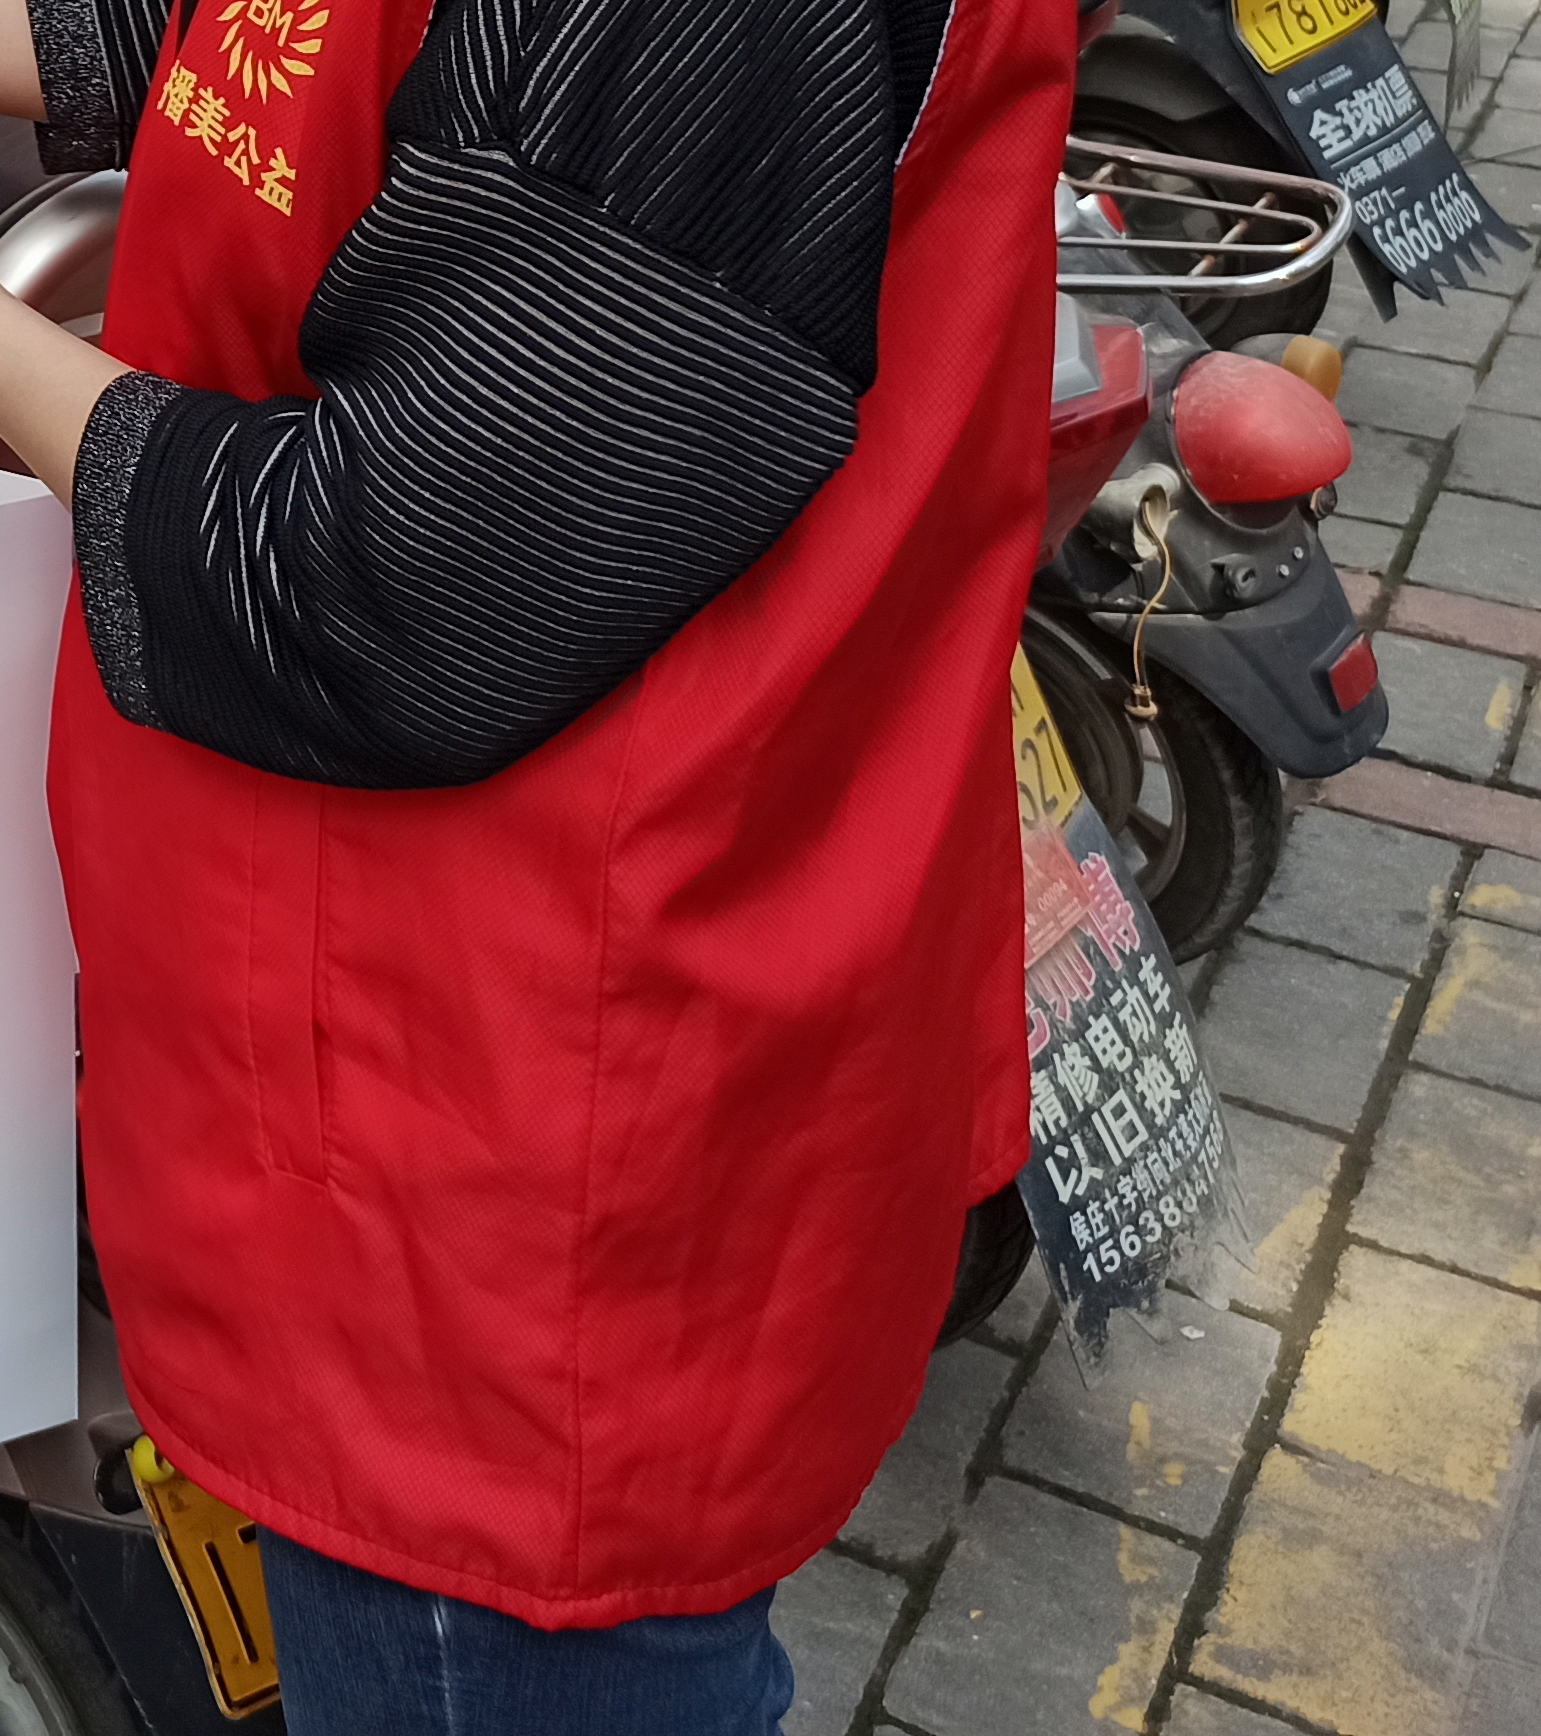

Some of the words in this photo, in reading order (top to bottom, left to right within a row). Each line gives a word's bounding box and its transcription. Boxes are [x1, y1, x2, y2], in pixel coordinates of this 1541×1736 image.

[1309, 63, 1417, 160] 全球机票
[1030, 953, 1171, 1145] 精修电动车
[1044, 1011, 1198, 1204] 以旧换新
